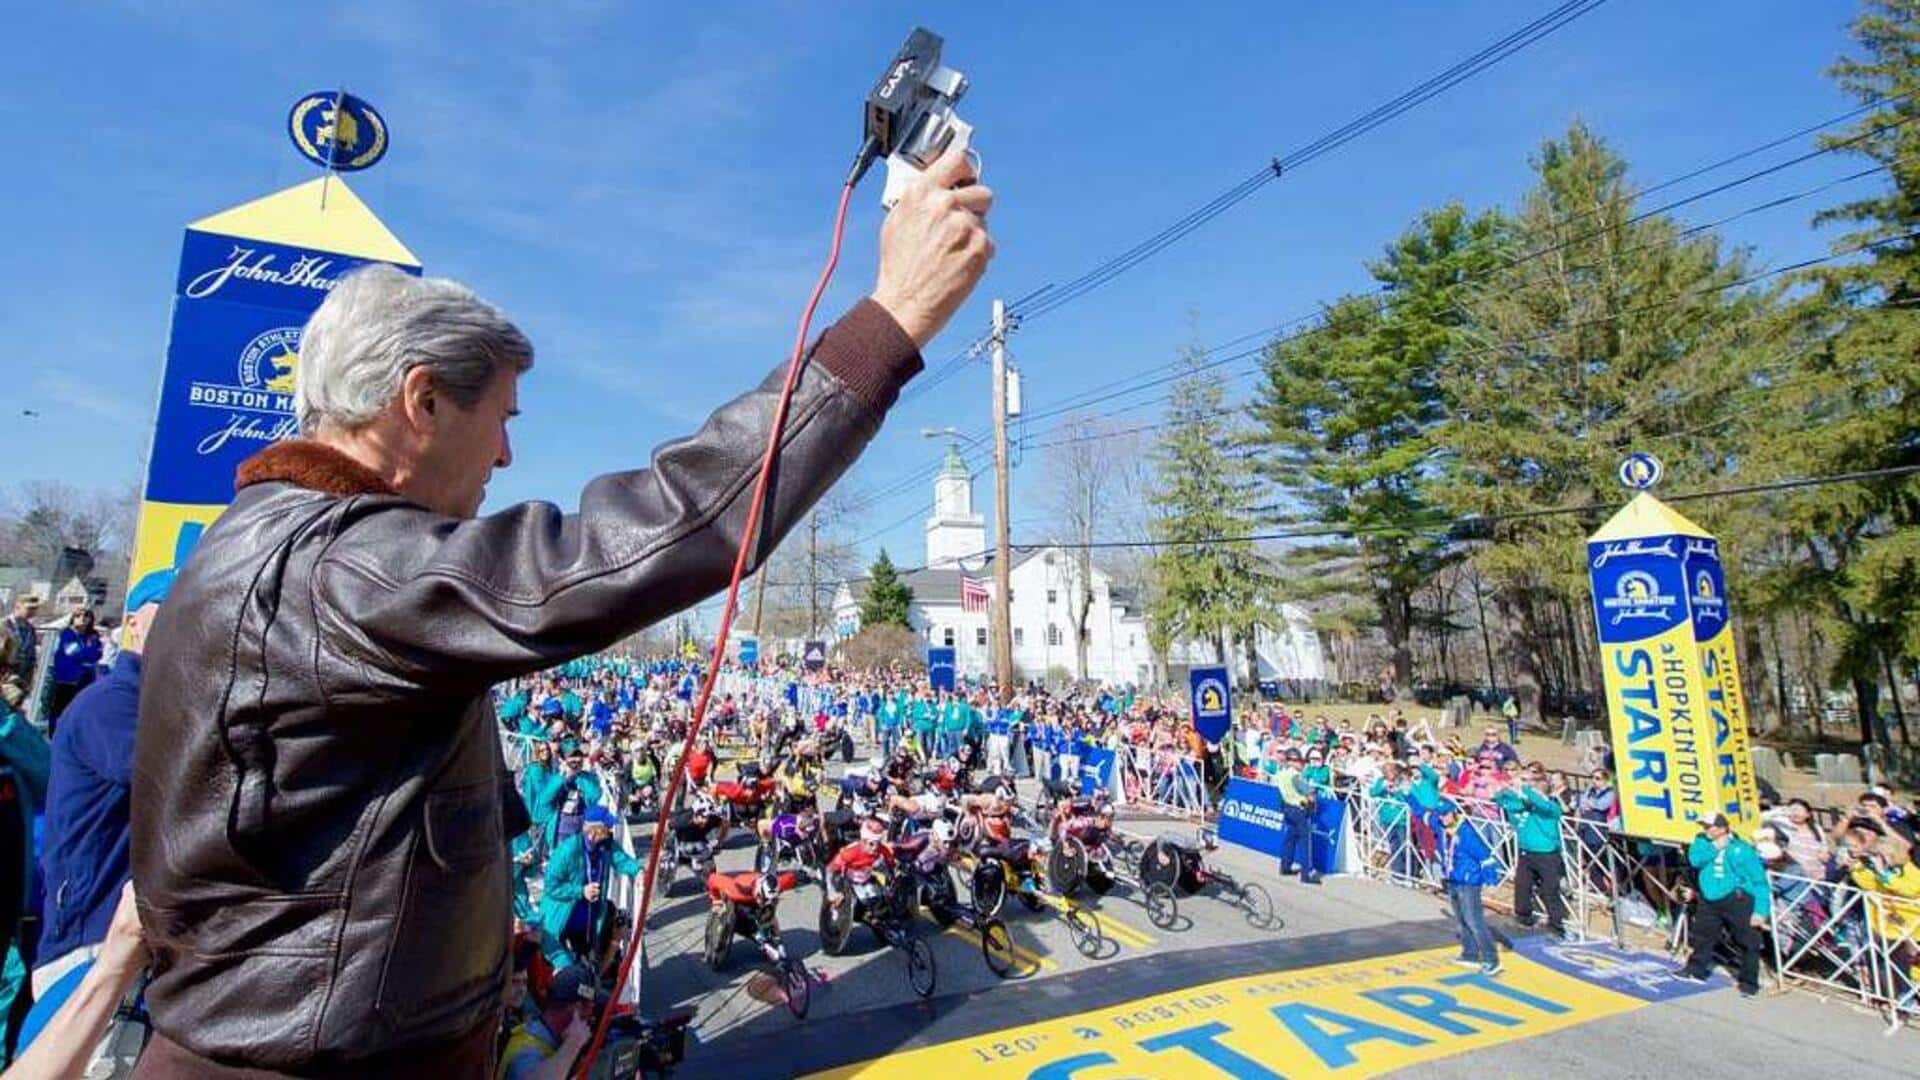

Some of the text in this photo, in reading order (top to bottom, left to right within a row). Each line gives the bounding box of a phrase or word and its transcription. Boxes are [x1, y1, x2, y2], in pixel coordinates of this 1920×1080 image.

[185, 245, 281, 299] John
[190, 386, 269, 408] BOSTON
[197, 413, 265, 454] John
[1615, 648, 1673, 820] START
[1661, 658, 1704, 804] HOPKINTON
[1702, 649, 1743, 822] START
[1721, 659, 1753, 803] HOPKINTON
[974, 1032, 1050, 1064] 120
[1112, 992, 1232, 1031] BOSTON
